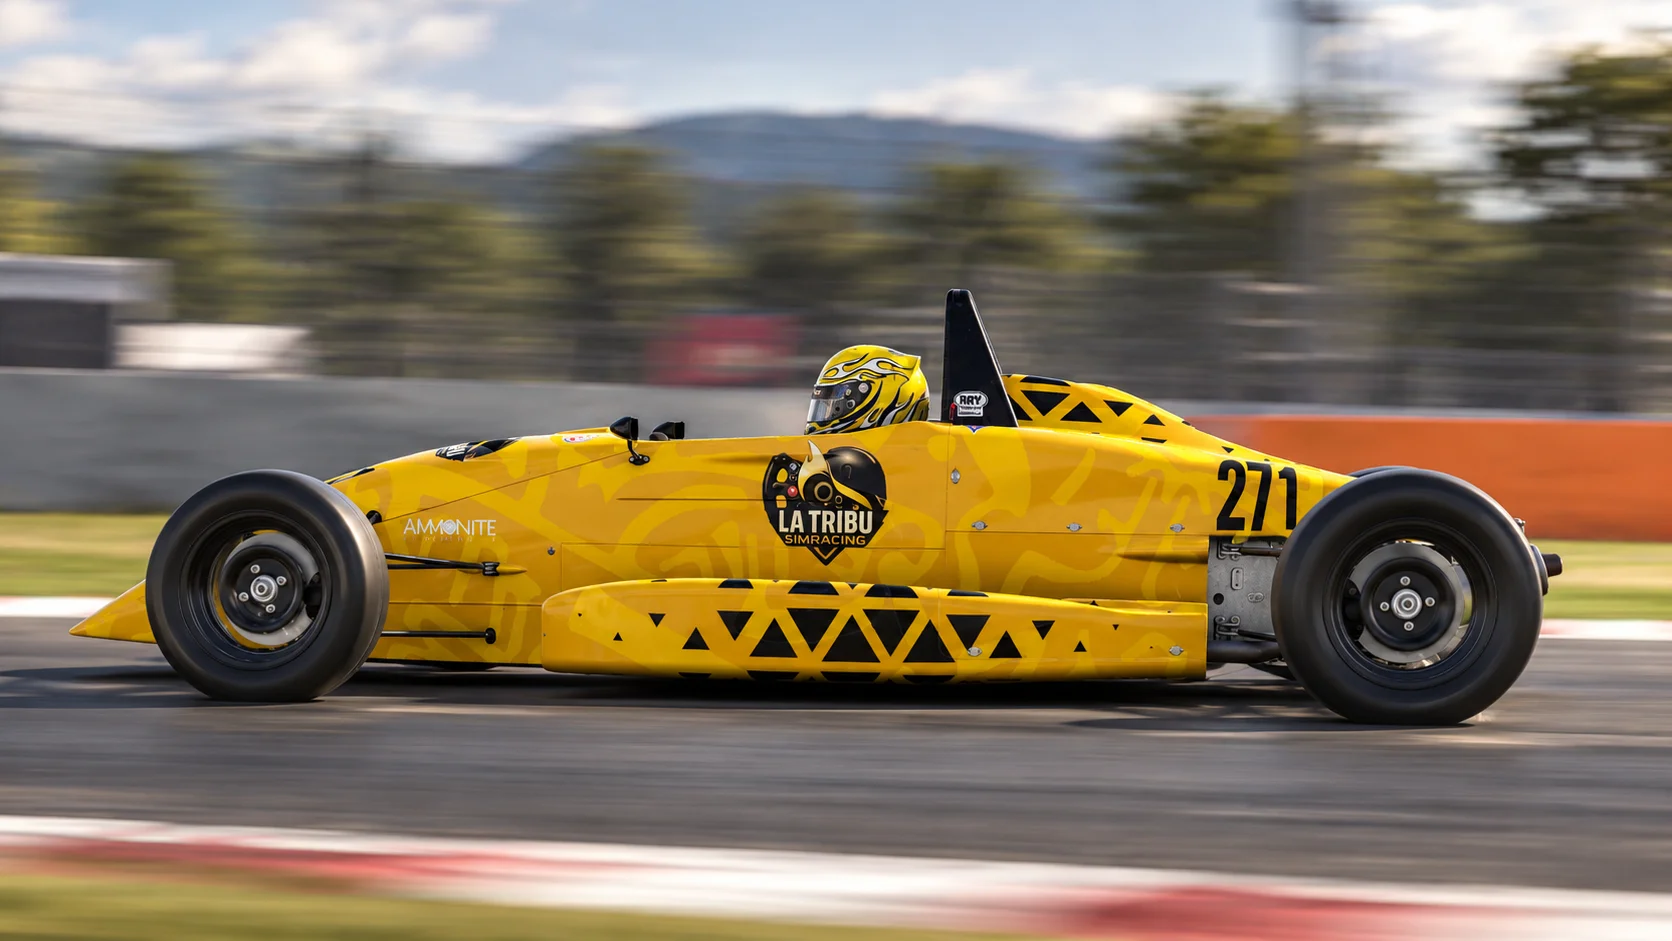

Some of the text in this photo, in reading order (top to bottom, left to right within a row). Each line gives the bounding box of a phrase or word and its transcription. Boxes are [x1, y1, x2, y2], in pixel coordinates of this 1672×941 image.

[1216, 459, 1297, 531] 271
[403, 518, 497, 536] AMMONITE
[778, 510, 873, 534] LA TRIBU
[784, 534, 866, 546] SIMRACING
